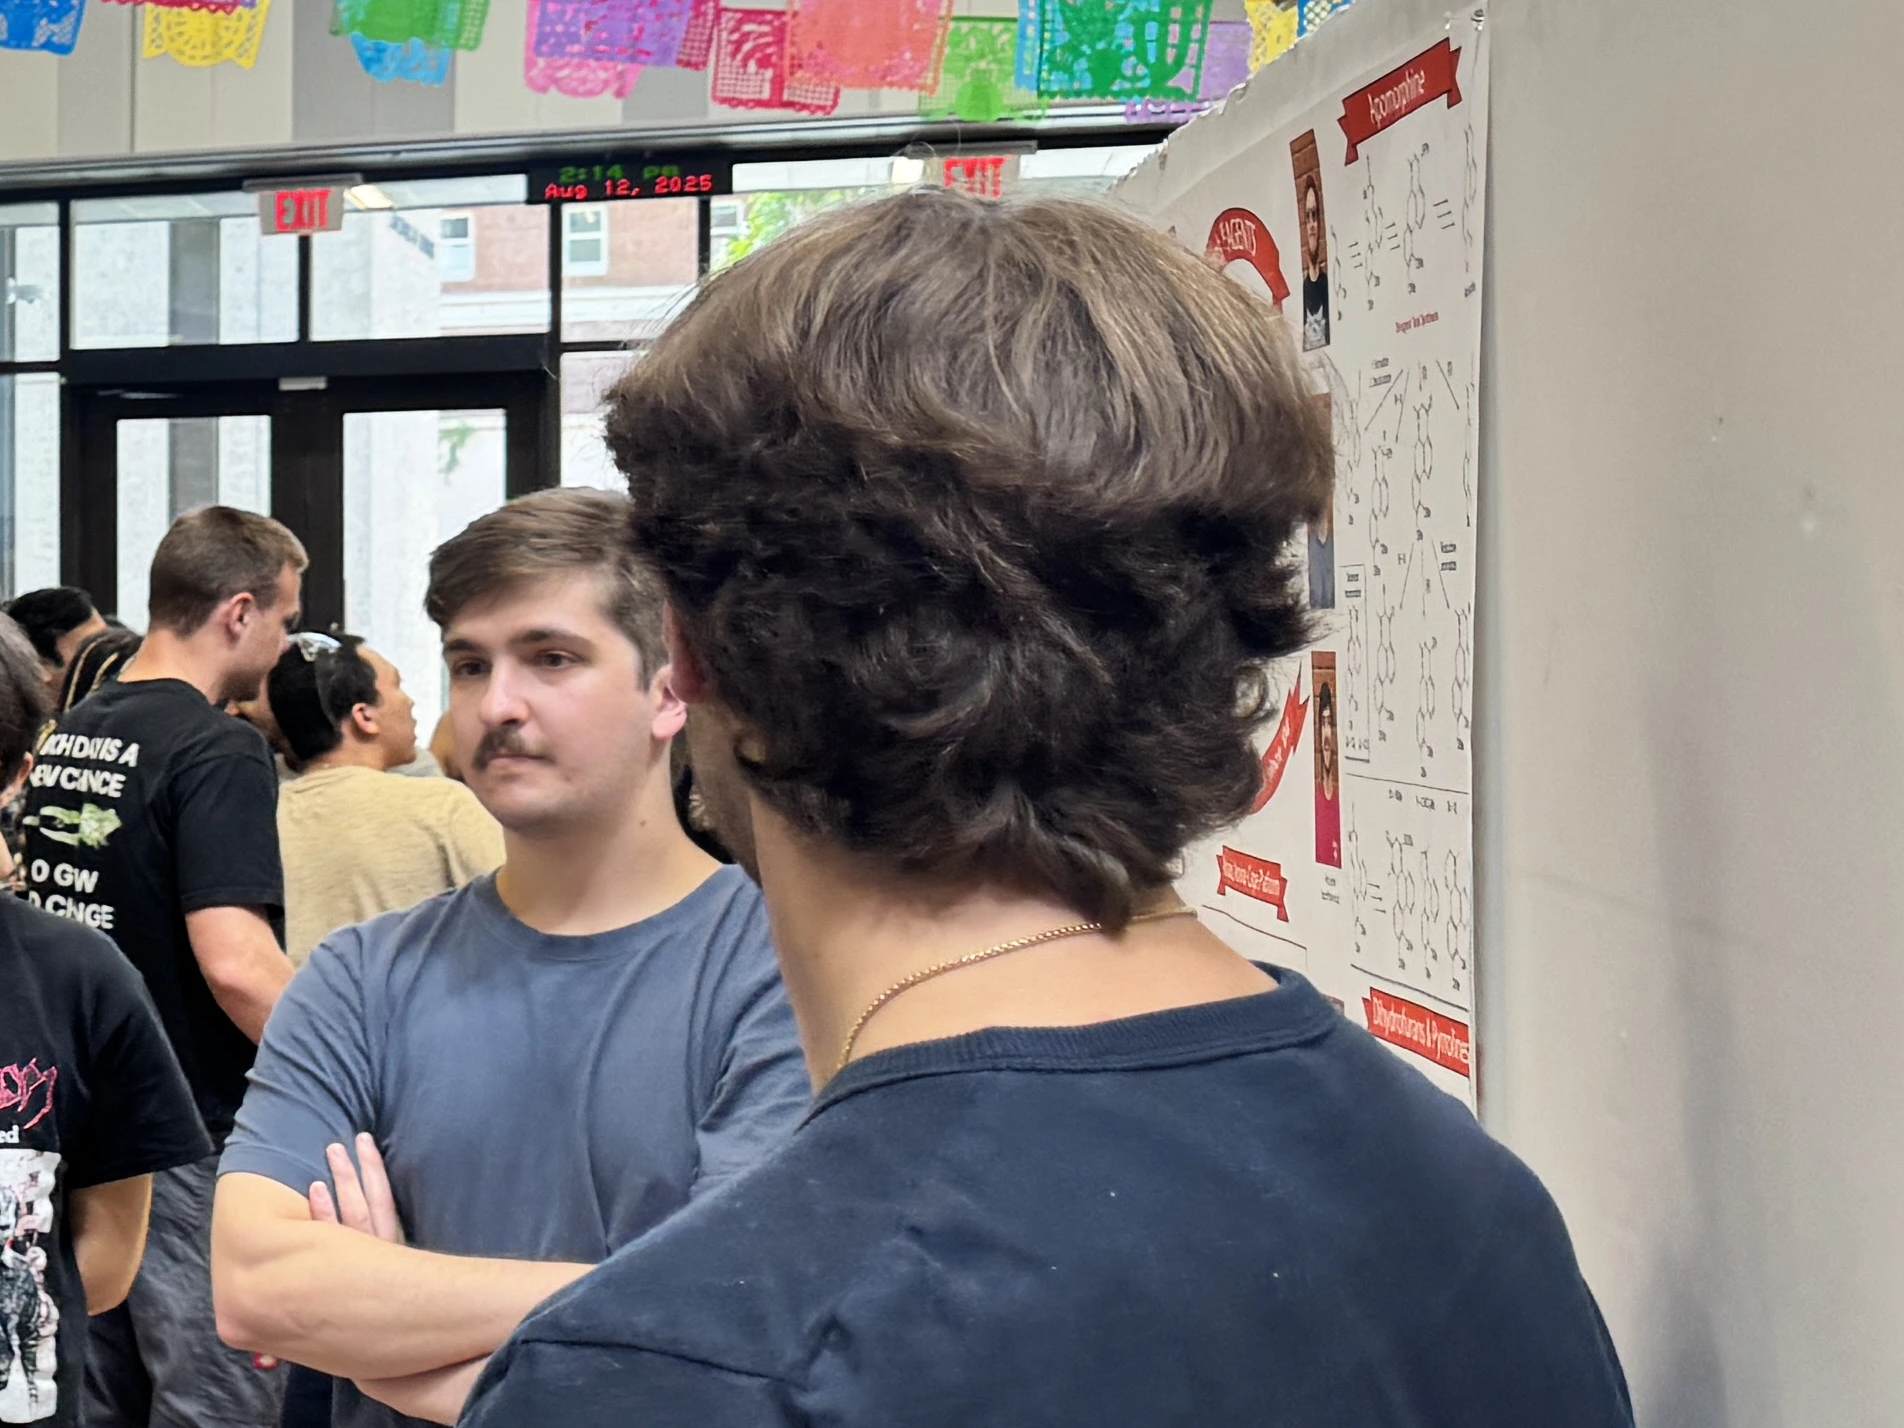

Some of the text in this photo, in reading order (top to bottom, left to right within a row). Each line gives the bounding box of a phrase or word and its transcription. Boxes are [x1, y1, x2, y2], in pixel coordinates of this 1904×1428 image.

[544, 174, 712, 200] Aug 12, 2025
[275, 188, 332, 231] EXIT
